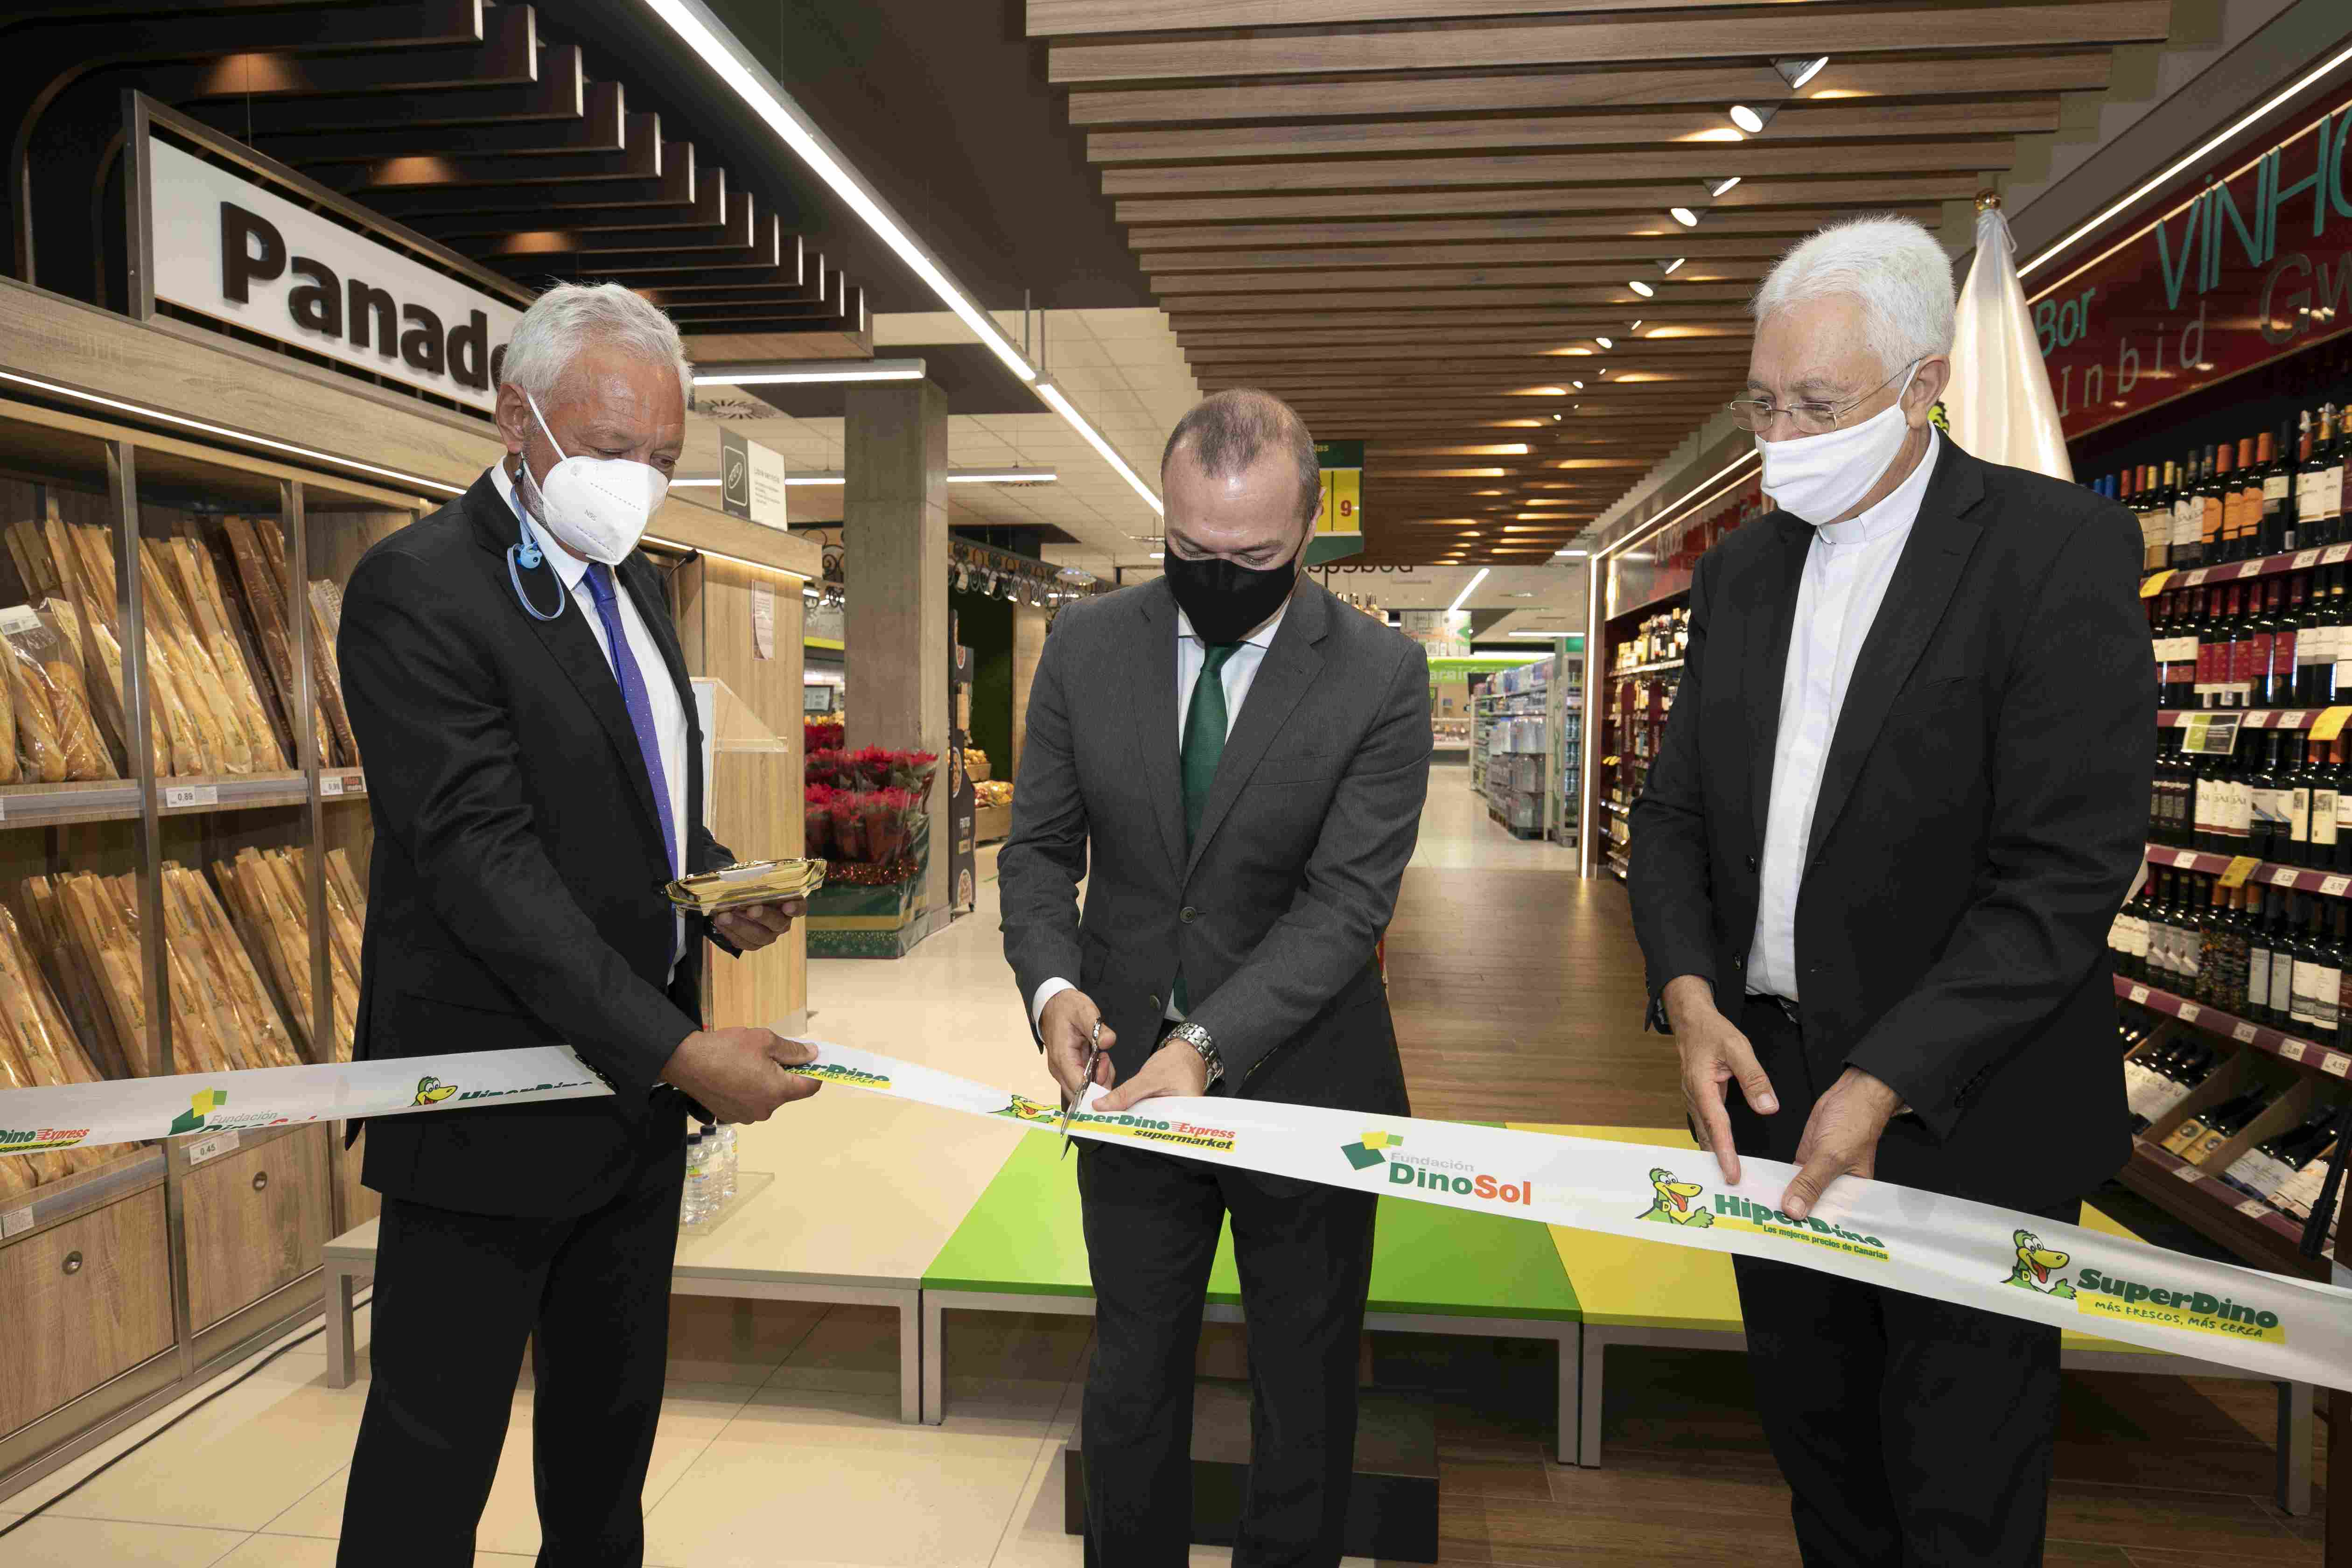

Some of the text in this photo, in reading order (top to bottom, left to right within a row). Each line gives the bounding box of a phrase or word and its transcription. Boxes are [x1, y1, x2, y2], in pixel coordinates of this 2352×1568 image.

[2036, 287, 2096, 358] Bor
[1340, 500, 1352, 517] 9
[1134, 1130, 1232, 1149] supermarket
[1177, 1122, 1236, 1139] Express
[1390, 1151, 1475, 1172] Fundación
[1388, 1162, 1531, 1206] DinoSol
[1764, 1225, 1888, 1260] Los mejores precios de Canarias
[2077, 1268, 2279, 1329] SuperDino
[2094, 1301, 2263, 1338] MÁS FRESCOS, MÁS CERCA
